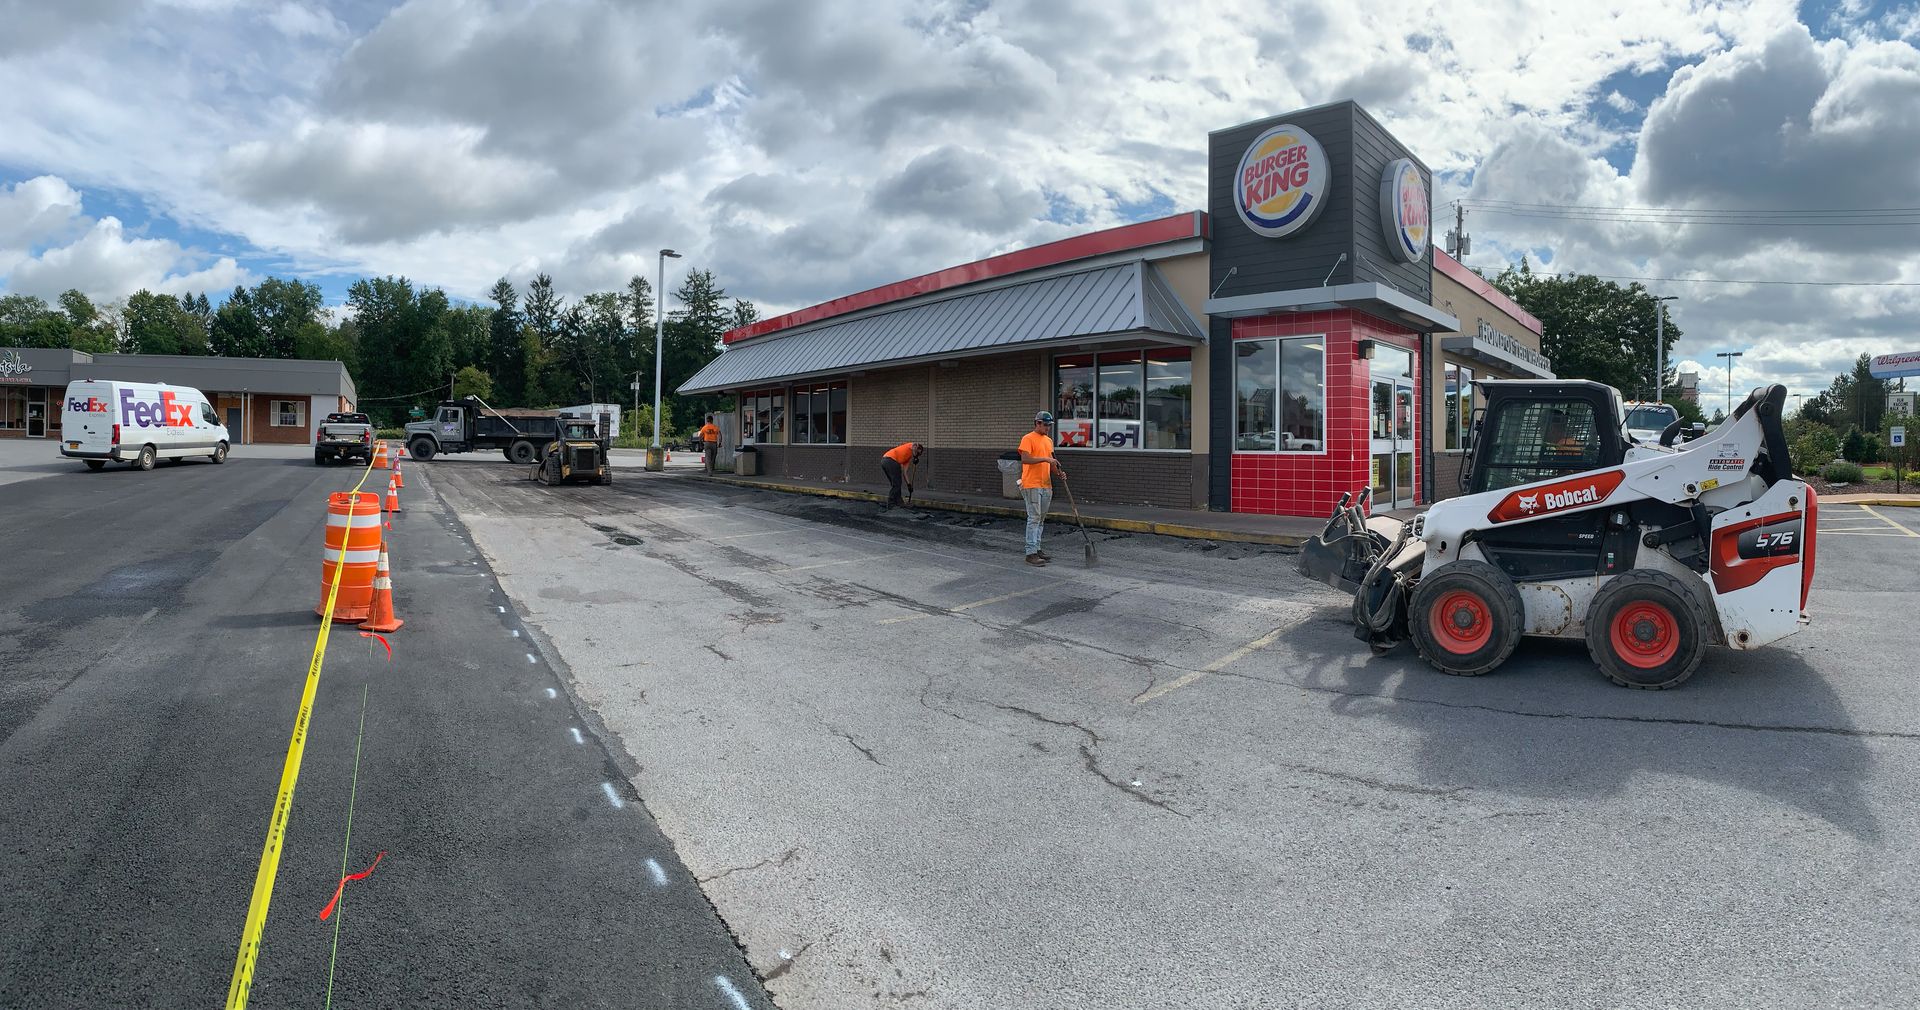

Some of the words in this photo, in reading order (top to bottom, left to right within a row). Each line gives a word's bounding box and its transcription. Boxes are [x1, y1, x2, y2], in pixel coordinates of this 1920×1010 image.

[1244, 145, 1307, 186] BURGER
[1246, 161, 1309, 210] KING
[67, 397, 107, 412] FedEx
[120, 388, 194, 428] FedEx
[167, 427, 184, 437] Express
[1544, 485, 1598, 510] Bobcat
[1756, 531, 1795, 548] S76
